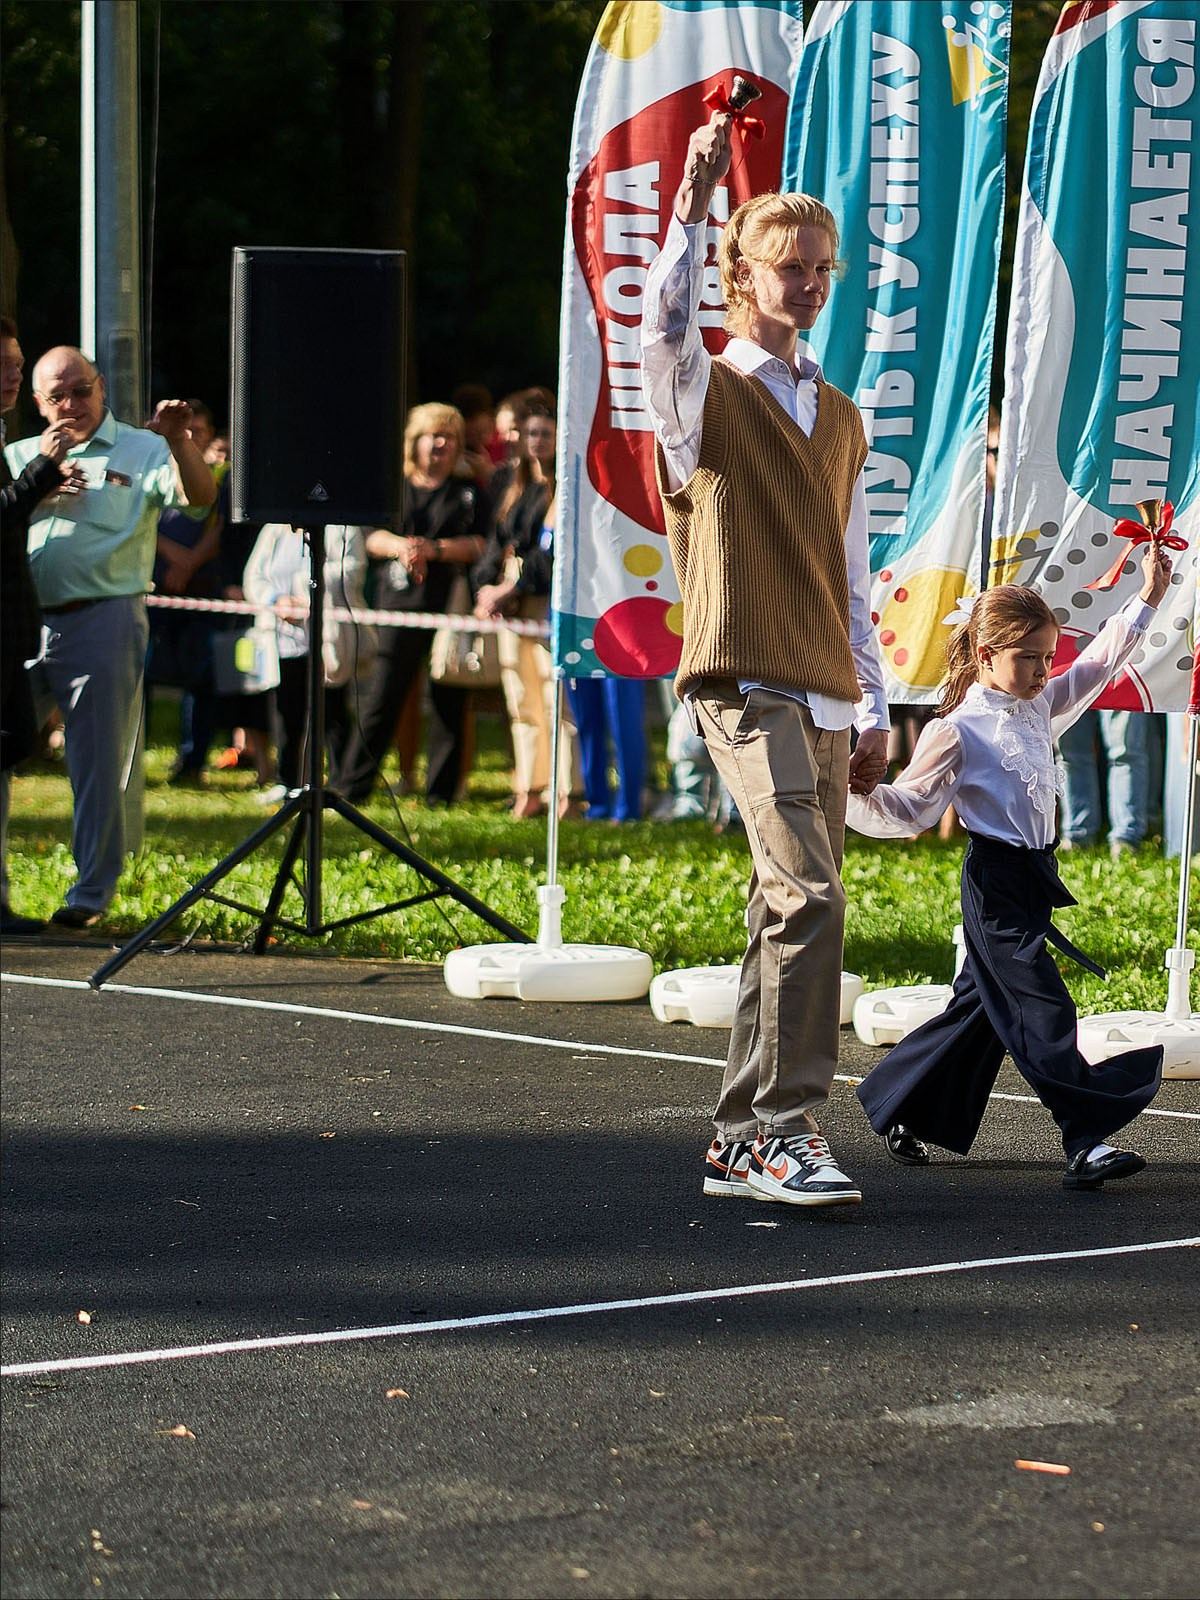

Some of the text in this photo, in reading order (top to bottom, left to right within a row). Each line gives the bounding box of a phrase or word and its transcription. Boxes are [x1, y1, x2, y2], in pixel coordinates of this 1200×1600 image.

[604, 161, 660, 431] ШКОЛА
[860, 31, 920, 535] ПУТЬ К УСПЕХУ
[1108, 18, 1196, 506] НАЧИНАЕТСЯ
